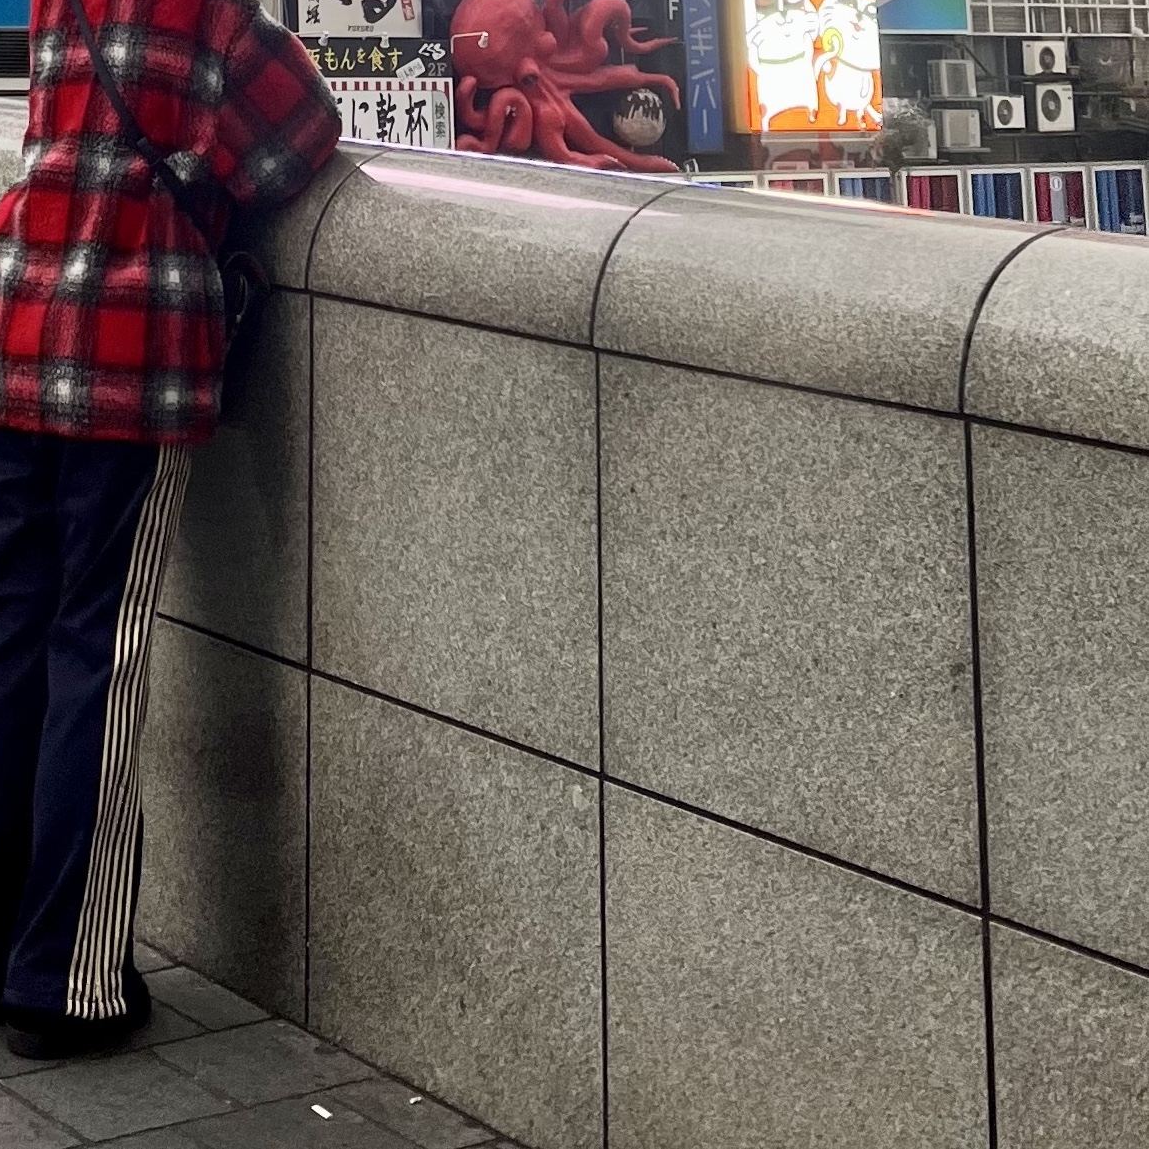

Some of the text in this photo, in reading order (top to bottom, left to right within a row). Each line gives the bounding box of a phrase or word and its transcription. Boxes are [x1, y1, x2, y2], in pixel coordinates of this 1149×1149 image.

[428, 63, 447, 76] 2F
[336, 93, 428, 146] に乾杯
